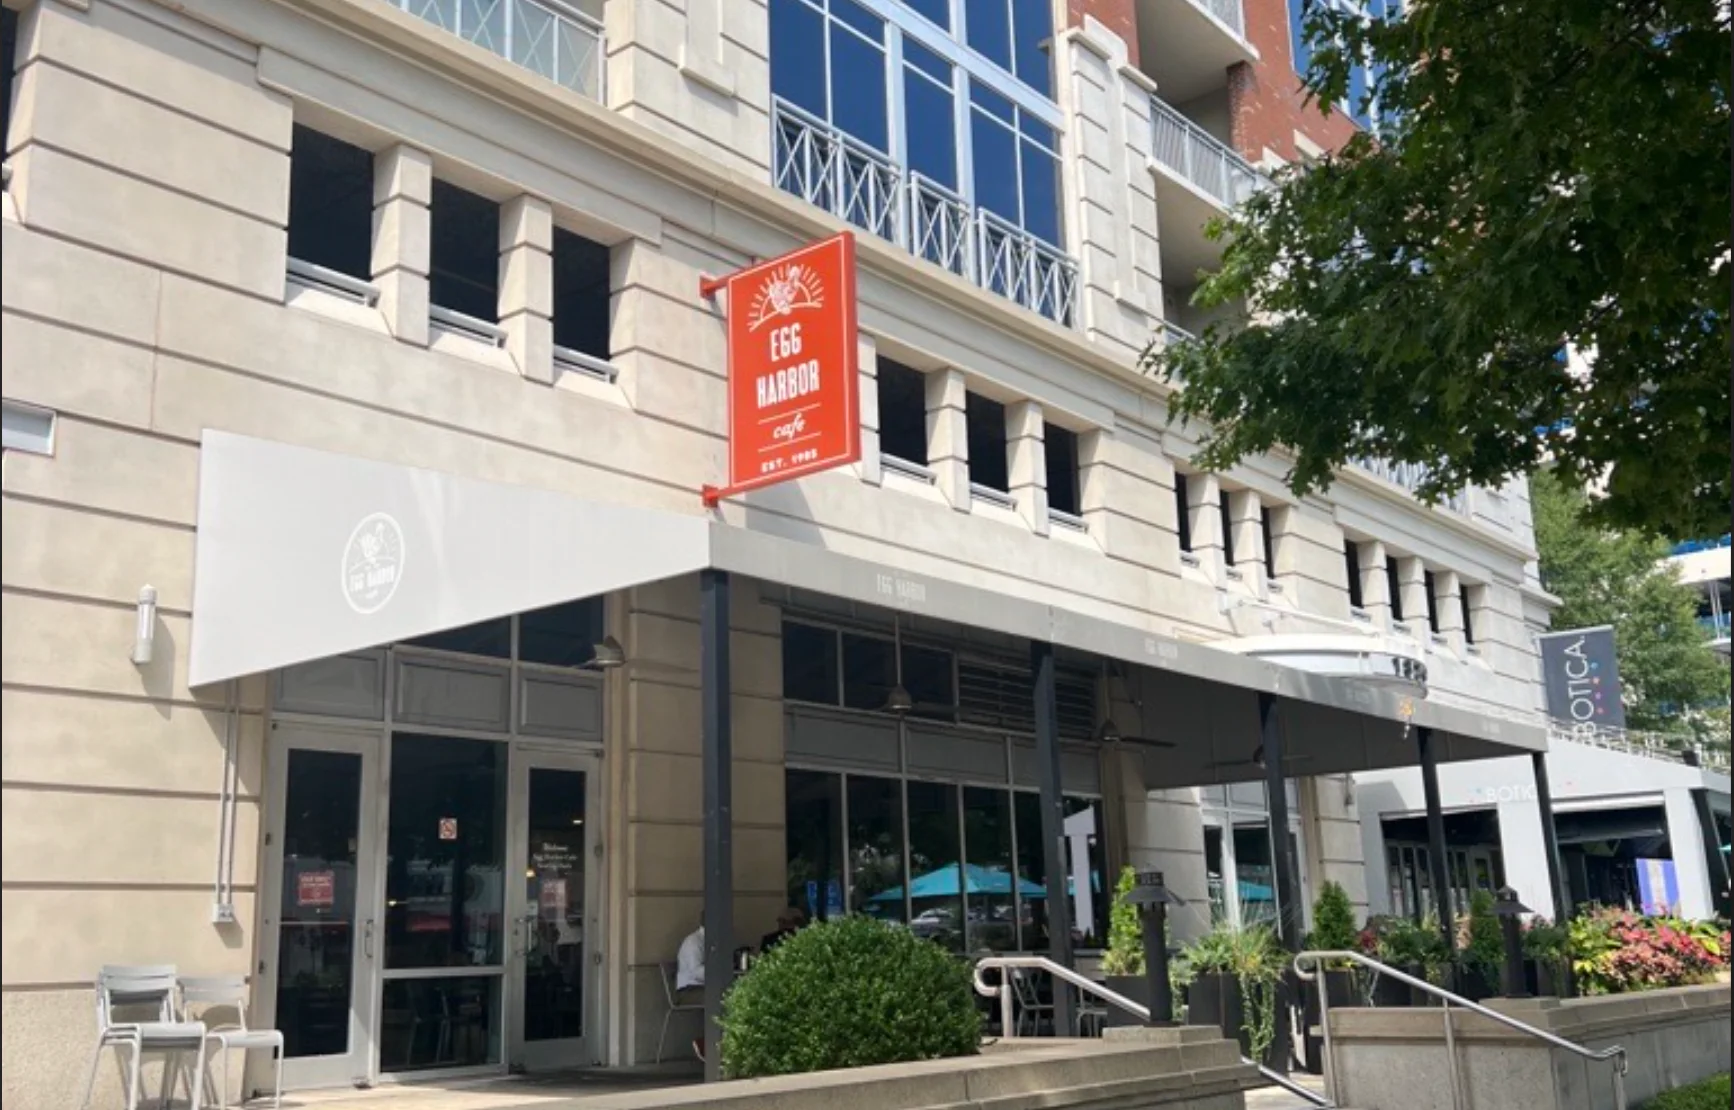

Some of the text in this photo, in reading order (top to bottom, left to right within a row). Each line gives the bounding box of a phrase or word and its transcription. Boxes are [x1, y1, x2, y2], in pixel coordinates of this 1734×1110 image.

[770, 322, 802, 362] EGG
[756, 359, 820, 409] HARBOR
[773, 412, 806, 440] cafe
